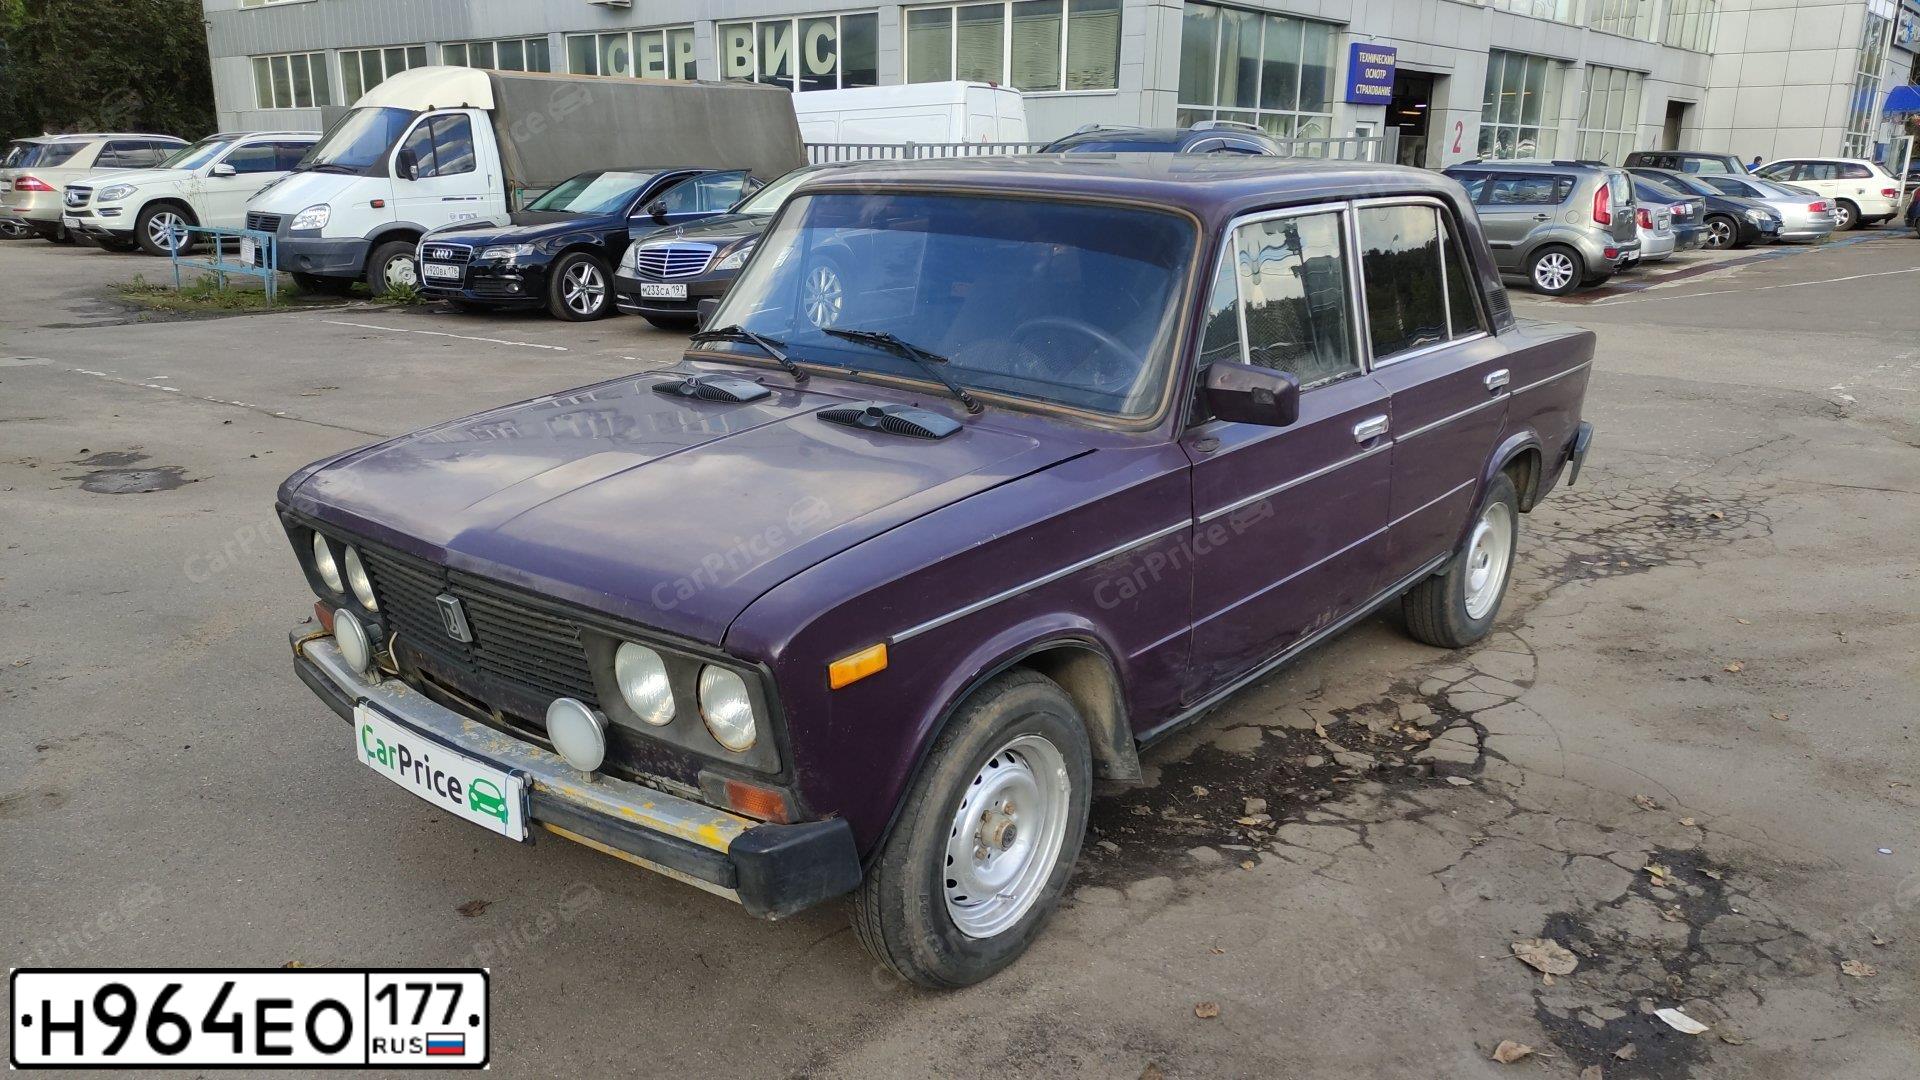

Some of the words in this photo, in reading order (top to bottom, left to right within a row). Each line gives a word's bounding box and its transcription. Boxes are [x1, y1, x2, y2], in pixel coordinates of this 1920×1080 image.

[1365, 68, 1387, 80] ОСМОТР
[1355, 84, 1391, 96] СТРАХОВАНИЕ
[1452, 120, 1463, 153] 2
[361, 724, 463, 804] CarPrice
